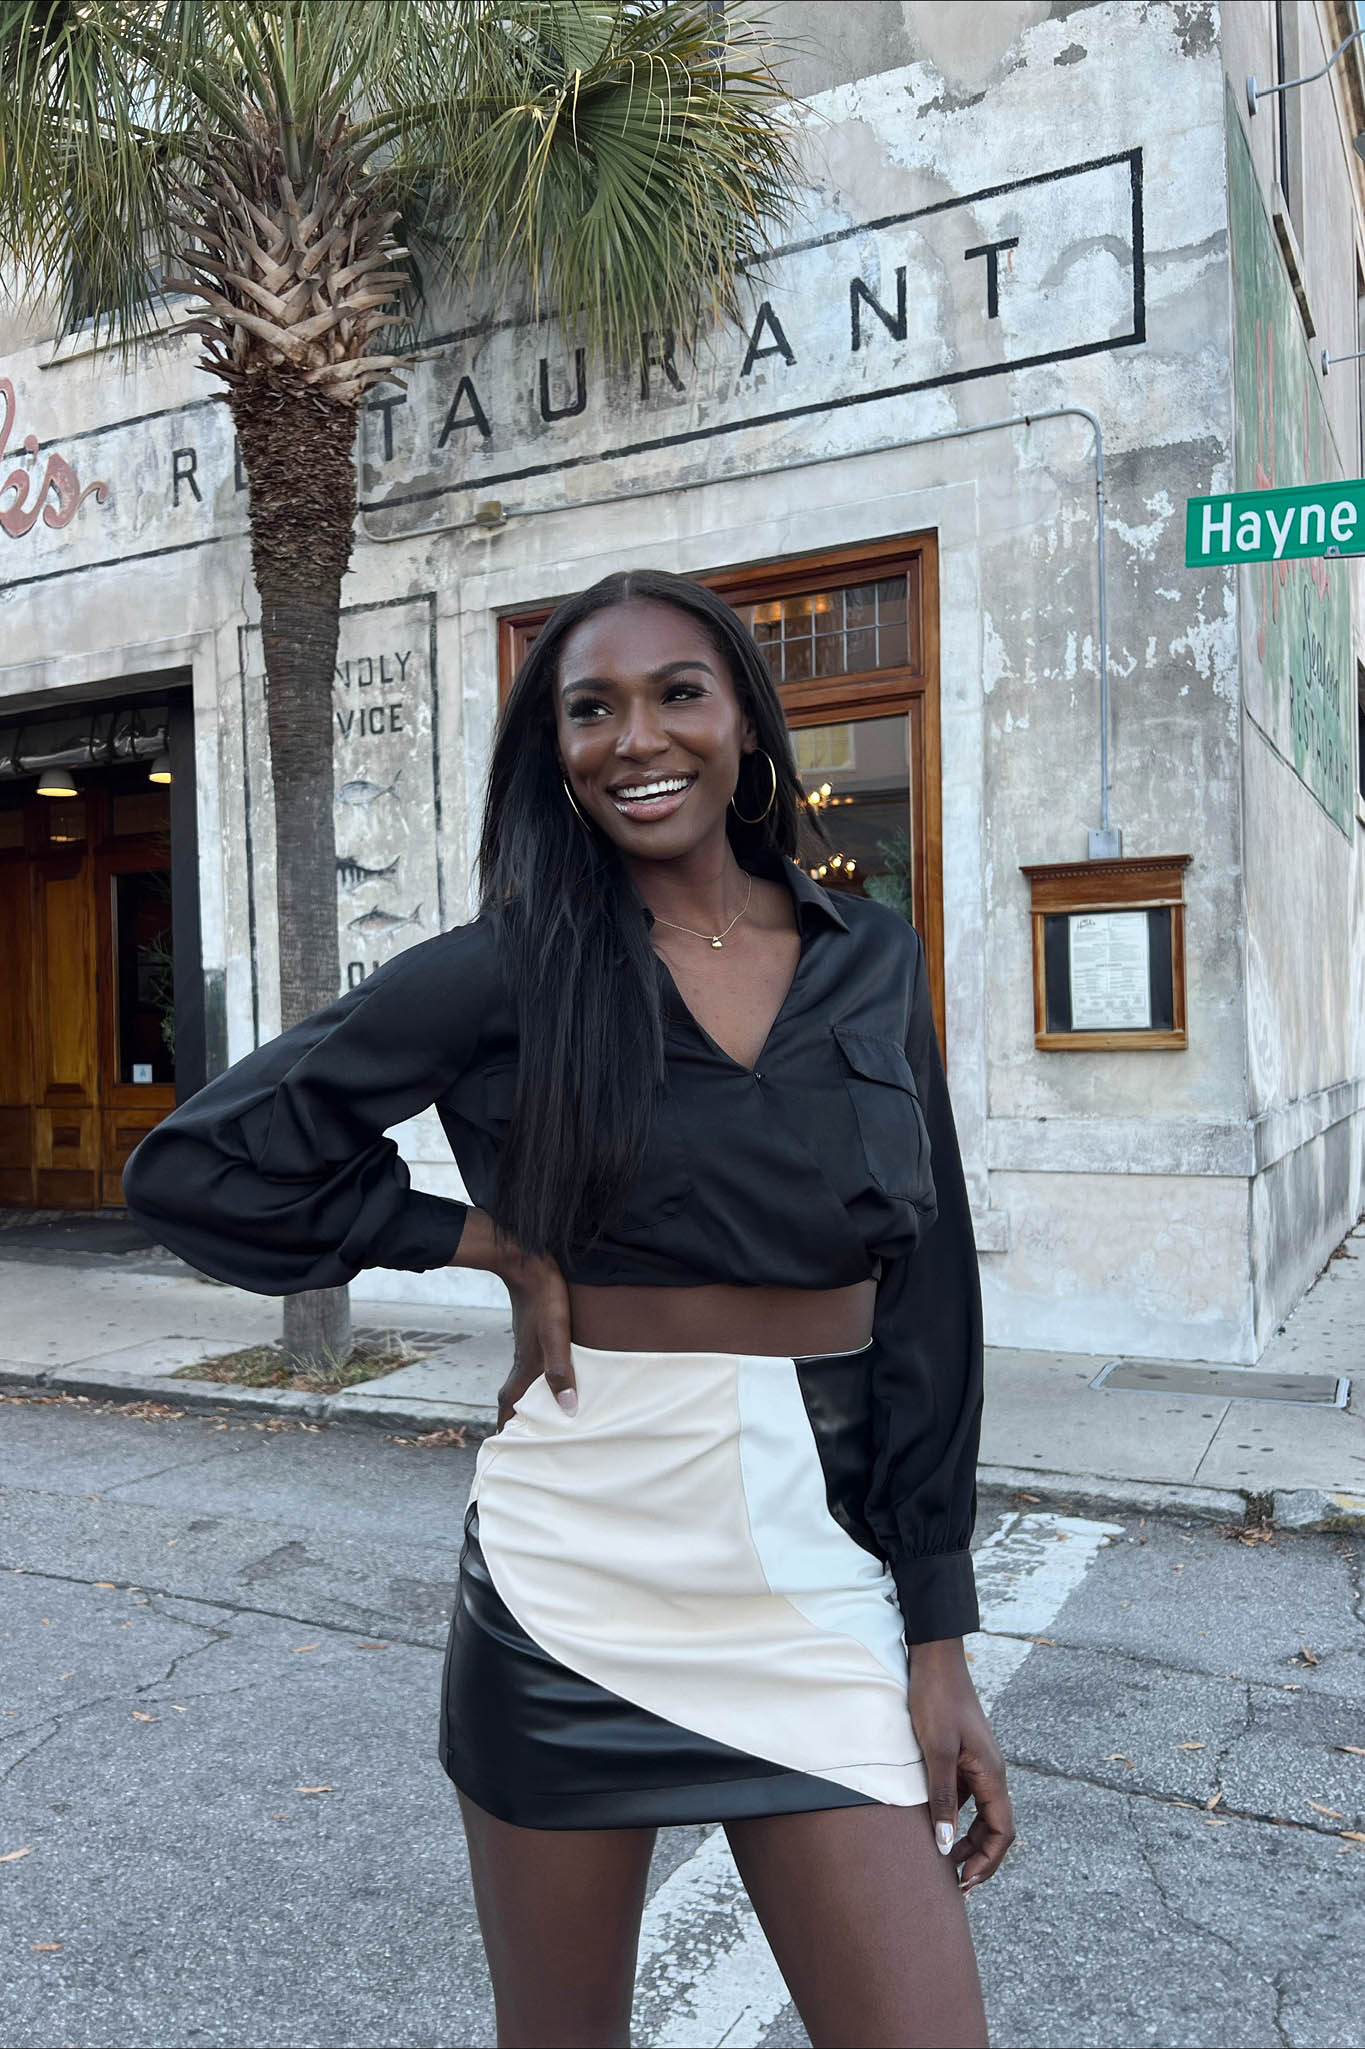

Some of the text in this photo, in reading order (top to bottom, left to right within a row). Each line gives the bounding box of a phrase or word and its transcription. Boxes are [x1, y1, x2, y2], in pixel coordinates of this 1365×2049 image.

[172, 237, 1019, 507] RTAURANT
[1202, 501, 1357, 558] Hayne
[336, 703, 403, 739] VICE
[1289, 674, 1349, 803] RESTAURANT
